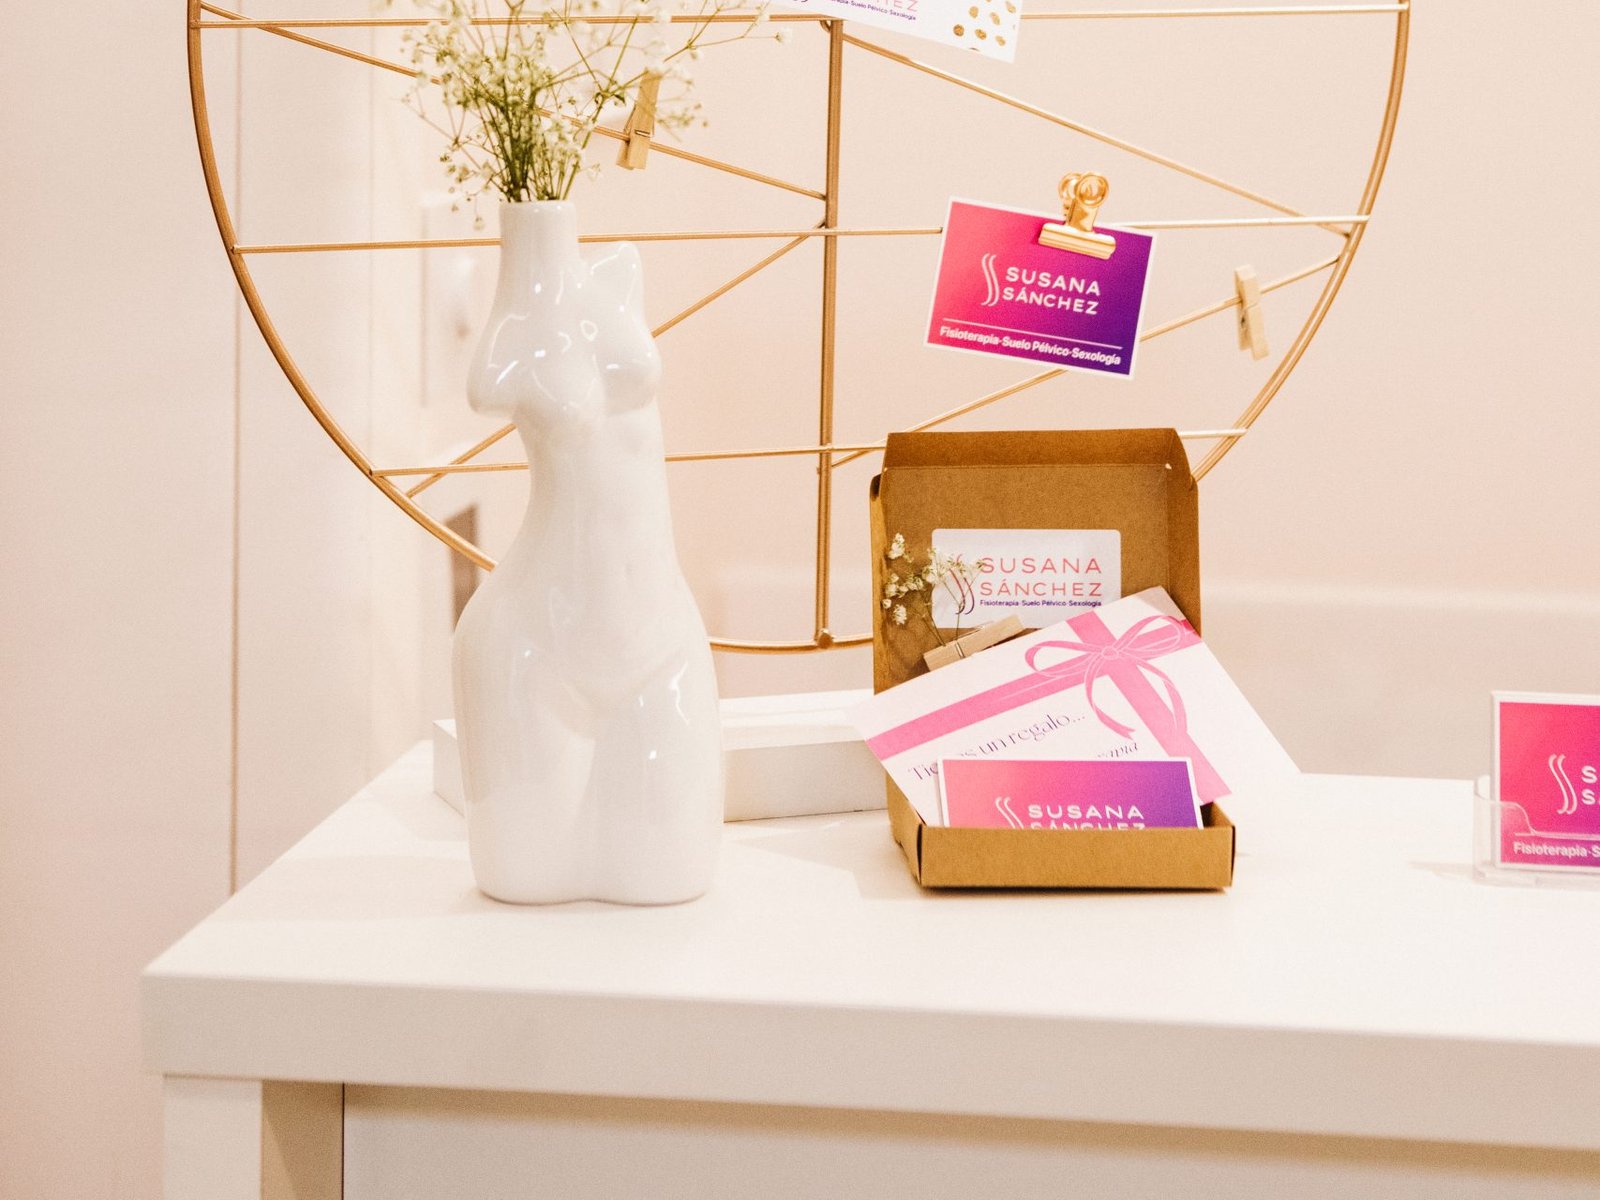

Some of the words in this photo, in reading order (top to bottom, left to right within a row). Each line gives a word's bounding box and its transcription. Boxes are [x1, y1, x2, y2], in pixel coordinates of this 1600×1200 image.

[1005, 266, 1100, 296] SUSANA
[1002, 286, 1099, 315] SÁNCHEZ
[980, 557, 1102, 574] SUSANA
[980, 578, 1102, 596] SÁNCHEZ
[978, 738, 1007, 756] un
[1028, 804, 1145, 820] SUSANA
